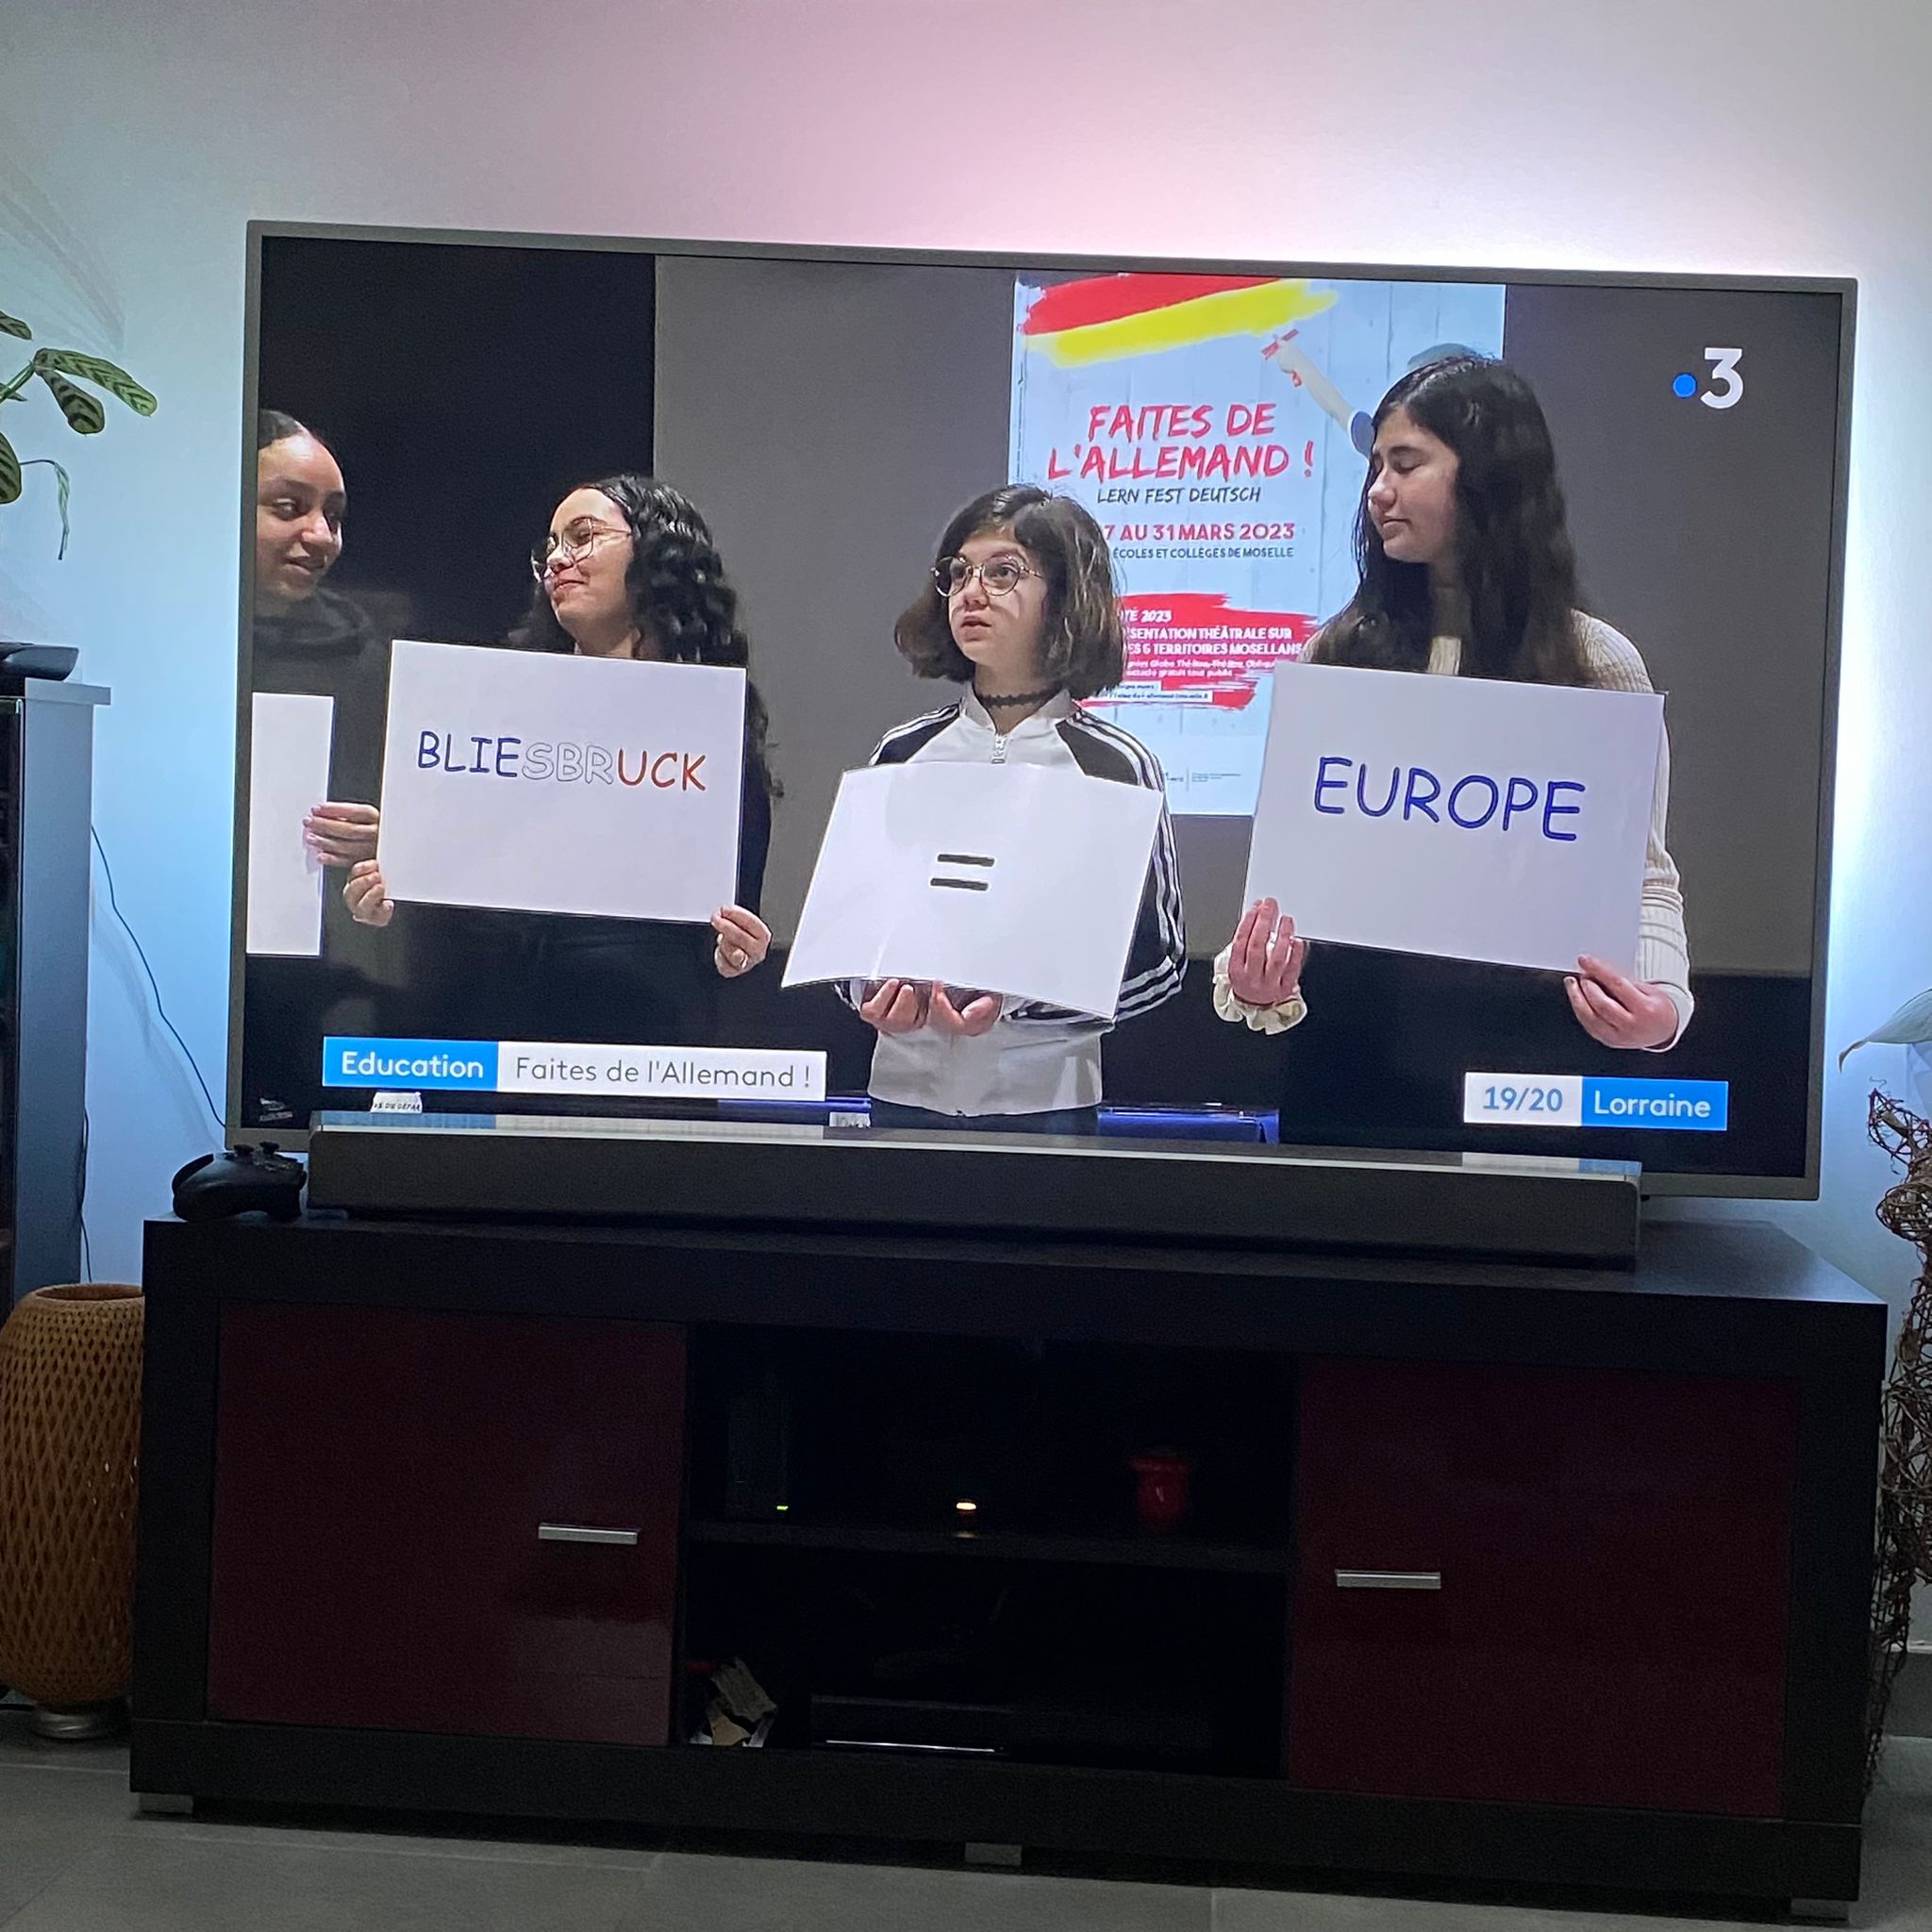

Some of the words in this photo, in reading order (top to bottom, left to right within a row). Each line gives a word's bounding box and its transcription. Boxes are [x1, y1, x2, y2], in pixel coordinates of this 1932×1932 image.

[1700, 347, 1743, 408] 3
[1088, 404, 1213, 442] FAITES
[1226, 404, 1276, 436] DE
[1047, 443, 1290, 483] L'ALLEMAND
[1304, 441, 1314, 477] !
[1097, 489, 1140, 504] LERN
[1144, 488, 1184, 504] FEST
[1189, 487, 1261, 503] DEUTSCH
[1120, 524, 1147, 541] AU
[1153, 524, 1174, 541] 31
[1178, 523, 1235, 541] MARS
[1239, 523, 1295, 541] 2023
[1156, 548, 1169, 558] ET
[1228, 547, 1241, 558] DE
[1242, 547, 1294, 558] MOSELLE
[1124, 626, 1198, 640] SENTATION
[1268, 626, 1292, 640] SUR
[1153, 642, 1228, 656] TERRITOIRES
[417, 730, 707, 791] BLIESBRUCK
[1314, 756, 1586, 841] EUROPE
[341, 1051, 484, 1079] Education
[516, 1057, 596, 1082] Faites
[606, 1059, 640, 1083] de
[648, 1060, 794, 1088] l'Allemand
[1482, 1087, 1563, 1112] 19/20
[1594, 1090, 1711, 1118] Lorraine
